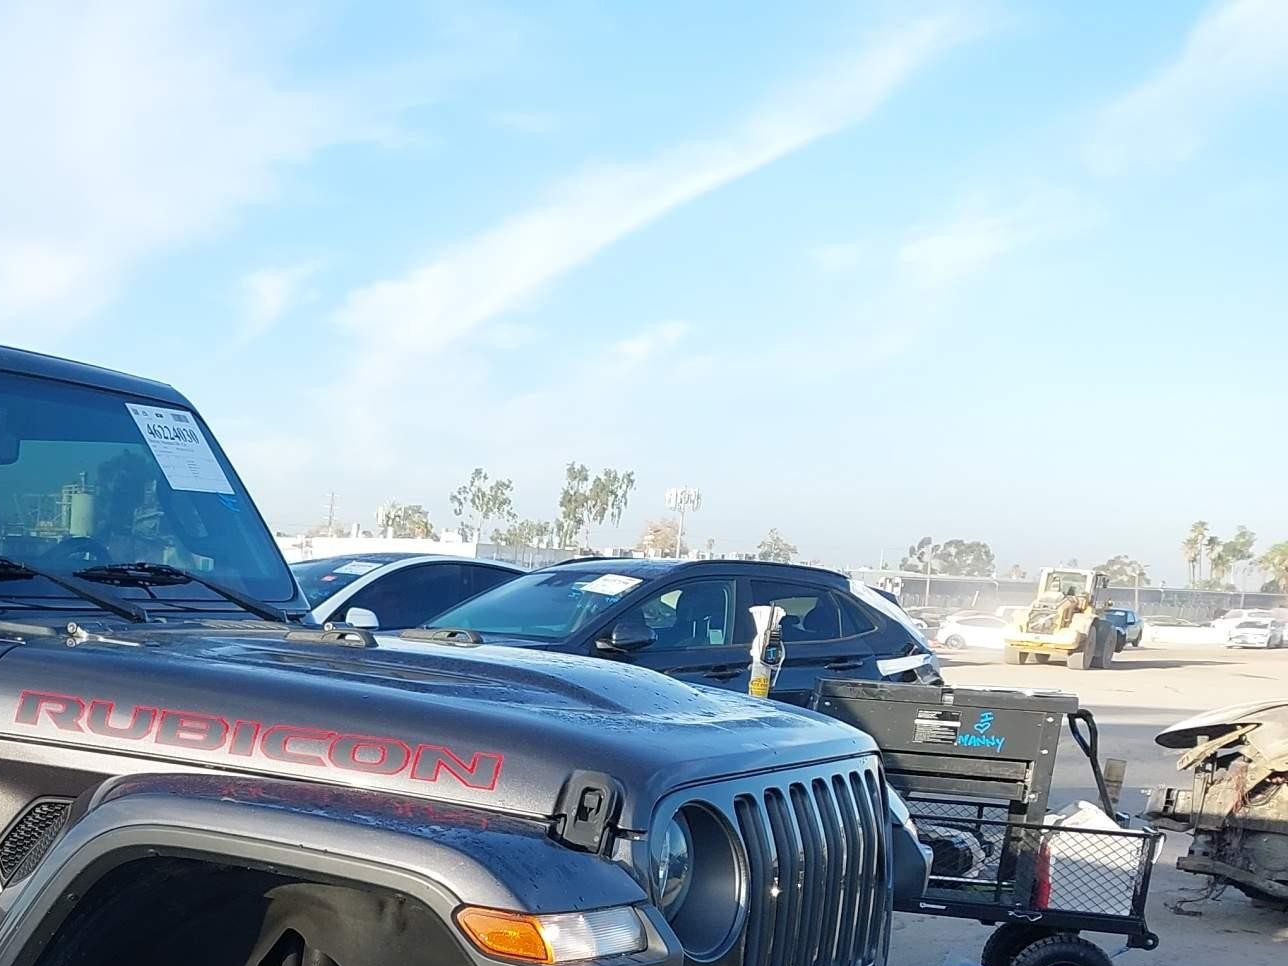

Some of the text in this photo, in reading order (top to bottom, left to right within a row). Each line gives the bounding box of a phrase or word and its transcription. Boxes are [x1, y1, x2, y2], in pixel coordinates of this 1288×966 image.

[145, 423, 200, 444] 46224030
[14, 689, 505, 791] RUBICON
[957, 733, 1005, 753] MANNY
